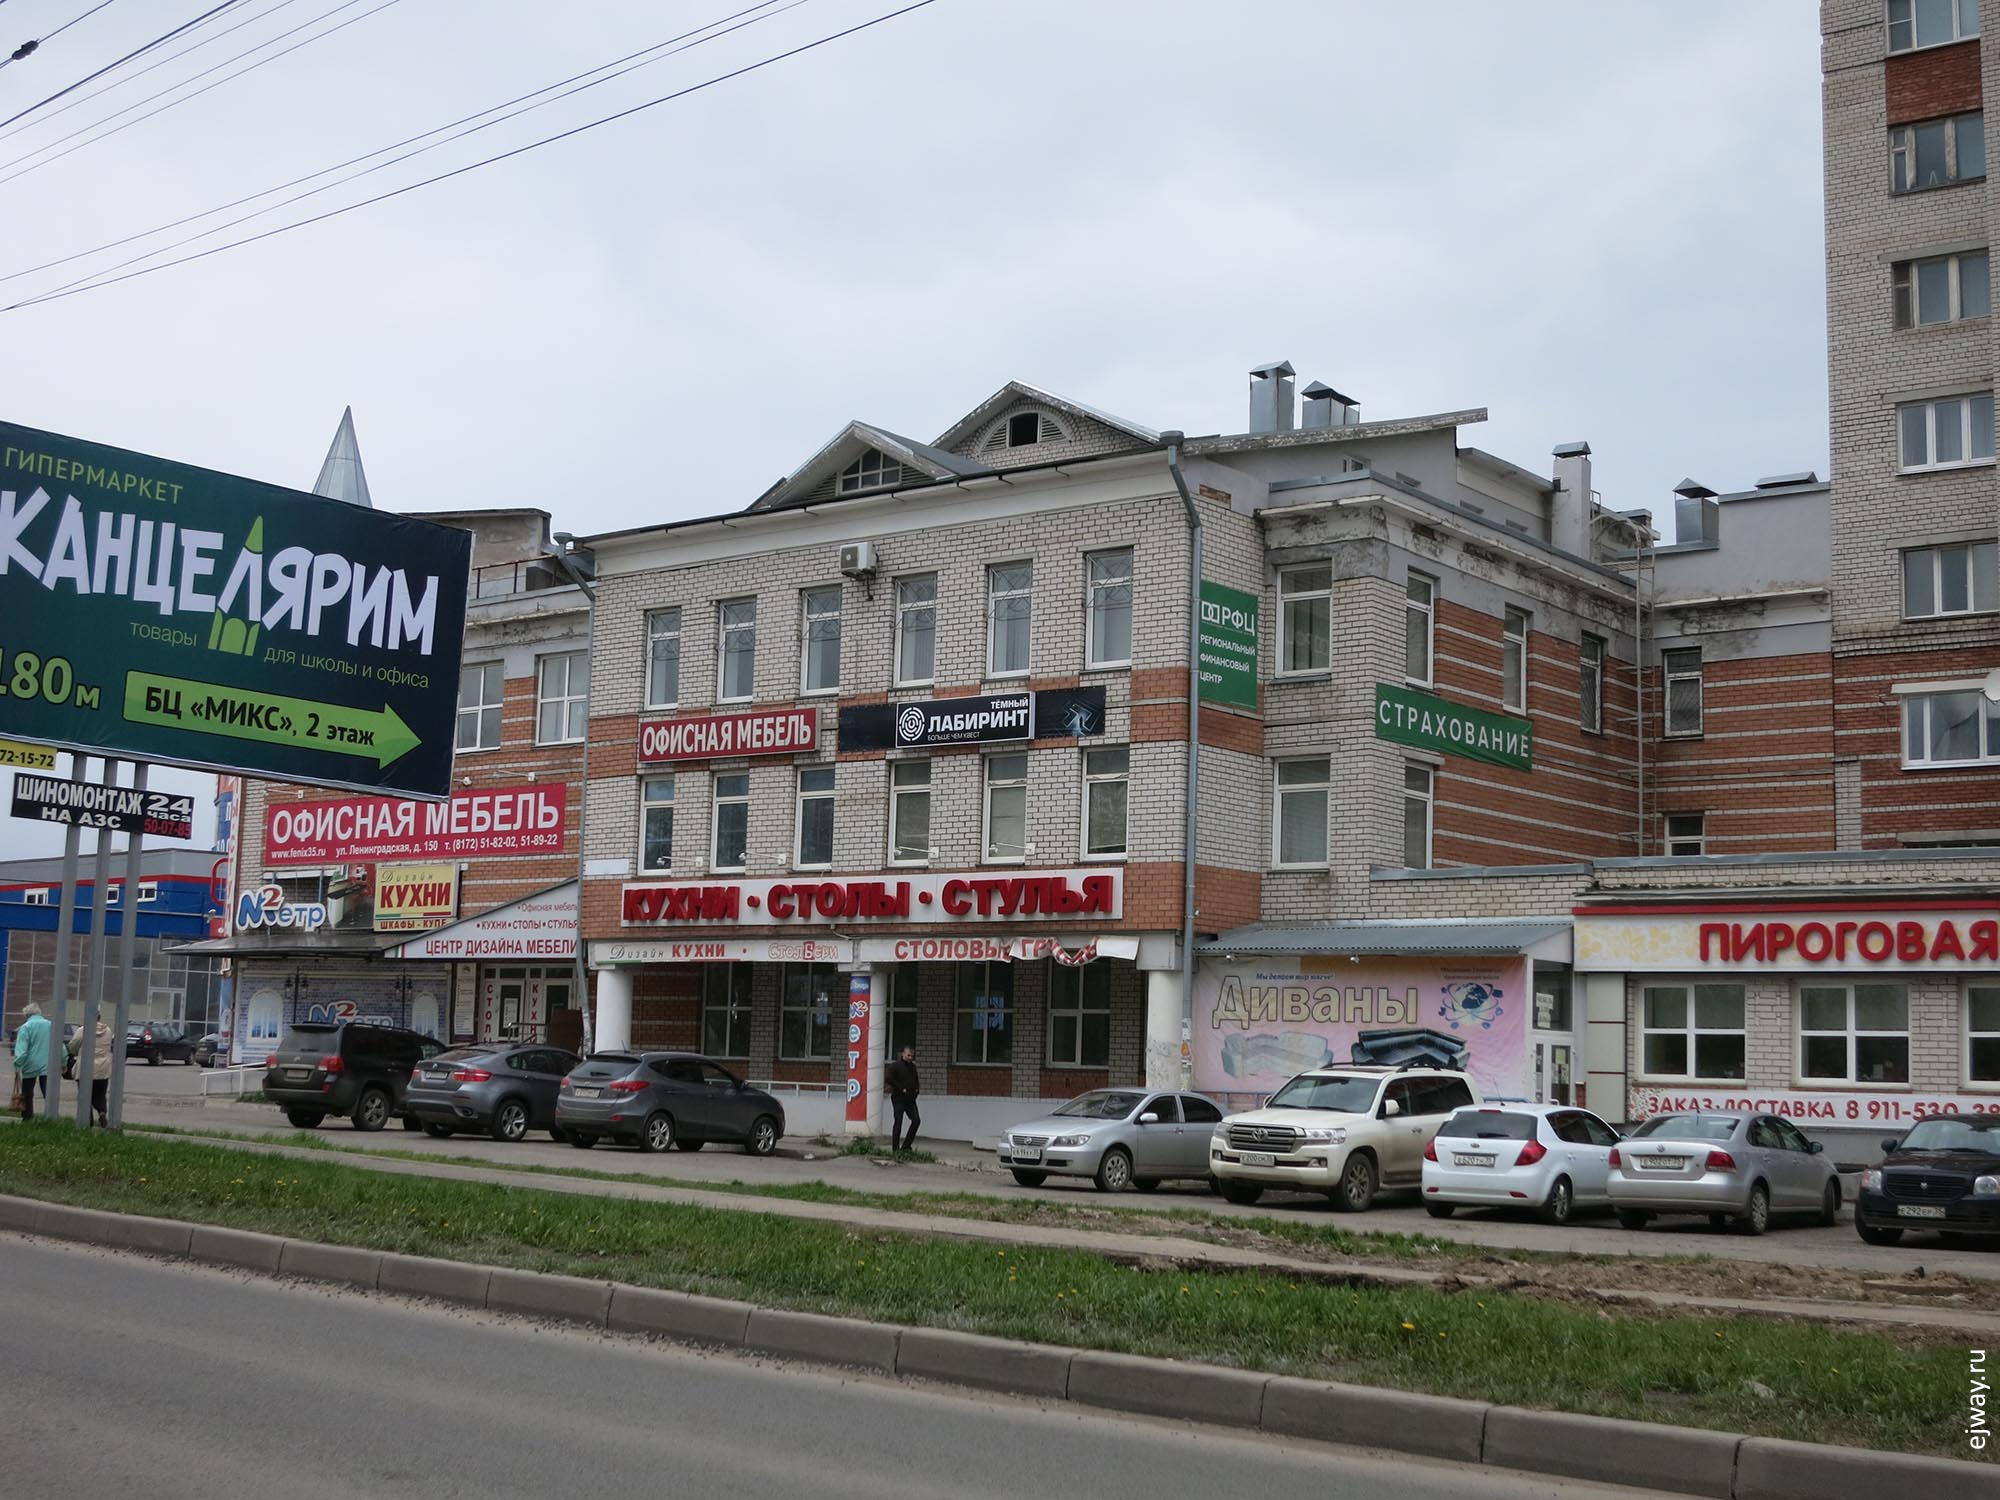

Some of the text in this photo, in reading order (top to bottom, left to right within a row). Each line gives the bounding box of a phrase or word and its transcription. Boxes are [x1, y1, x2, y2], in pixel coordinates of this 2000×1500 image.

[6, 447, 183, 504] ГИПЕРМАРКЕТ
[0, 486, 438, 656] КАНЦЕЛЯРИМ
[130, 622, 197, 647] товары
[1200, 634, 1256, 656] РЕГИОНАЛЬНЫЙ
[264, 648, 429, 688] для школы и офиса
[1200, 653, 1250, 672] ФИНАНСОВЫЙ
[1200, 671, 1223, 684] ЦЕНТР
[146, 687, 374, 746] БЦ «МИКС», 2 этаж
[928, 709, 1028, 732] ЛАБИРИНТ
[1379, 700, 1529, 757] СТРАХОВАНИЕ
[643, 714, 811, 756] ОФИСНАЯ МЕБЕЛЬ
[17, 776, 192, 815] ШИНОМОНТАЖ 24
[41, 806, 121, 829] НА АЗС
[144, 818, 191, 837] 50-07-85
[147, 810, 191, 823] часа
[273, 801, 416, 844] ОФИСНАЯ
[425, 792, 559, 835] МЕБЕЛЬ
[272, 834, 558, 859] www.fenix35.ru ул. Ленинградская, д. 150 т. (8172) 51-82-02, 51-89-22
[381, 870, 433, 882] Дизайн
[381, 882, 451, 908] КУХНИ
[623, 875, 1114, 921] КУХНИ СТОЛЫ СТУЛЬЯ
[522, 903, 552, 912] Офисная
[381, 920, 415, 930] ШКАФЫ
[482, 919, 577, 929] КУХНИ СТОЛЫ СТУЛЬЯ
[426, 937, 577, 956] ЦЕНТР ДИЗАЙНА МЕБЕЛИ
[609, 945, 664, 959] Дизайн
[672, 944, 725, 957] КУХНИ
[1699, 919, 1999, 962] ПИРОГОВАЯ
[1212, 975, 1418, 1030] Диваны
[1846, 1100, 1860, 1119] 8
